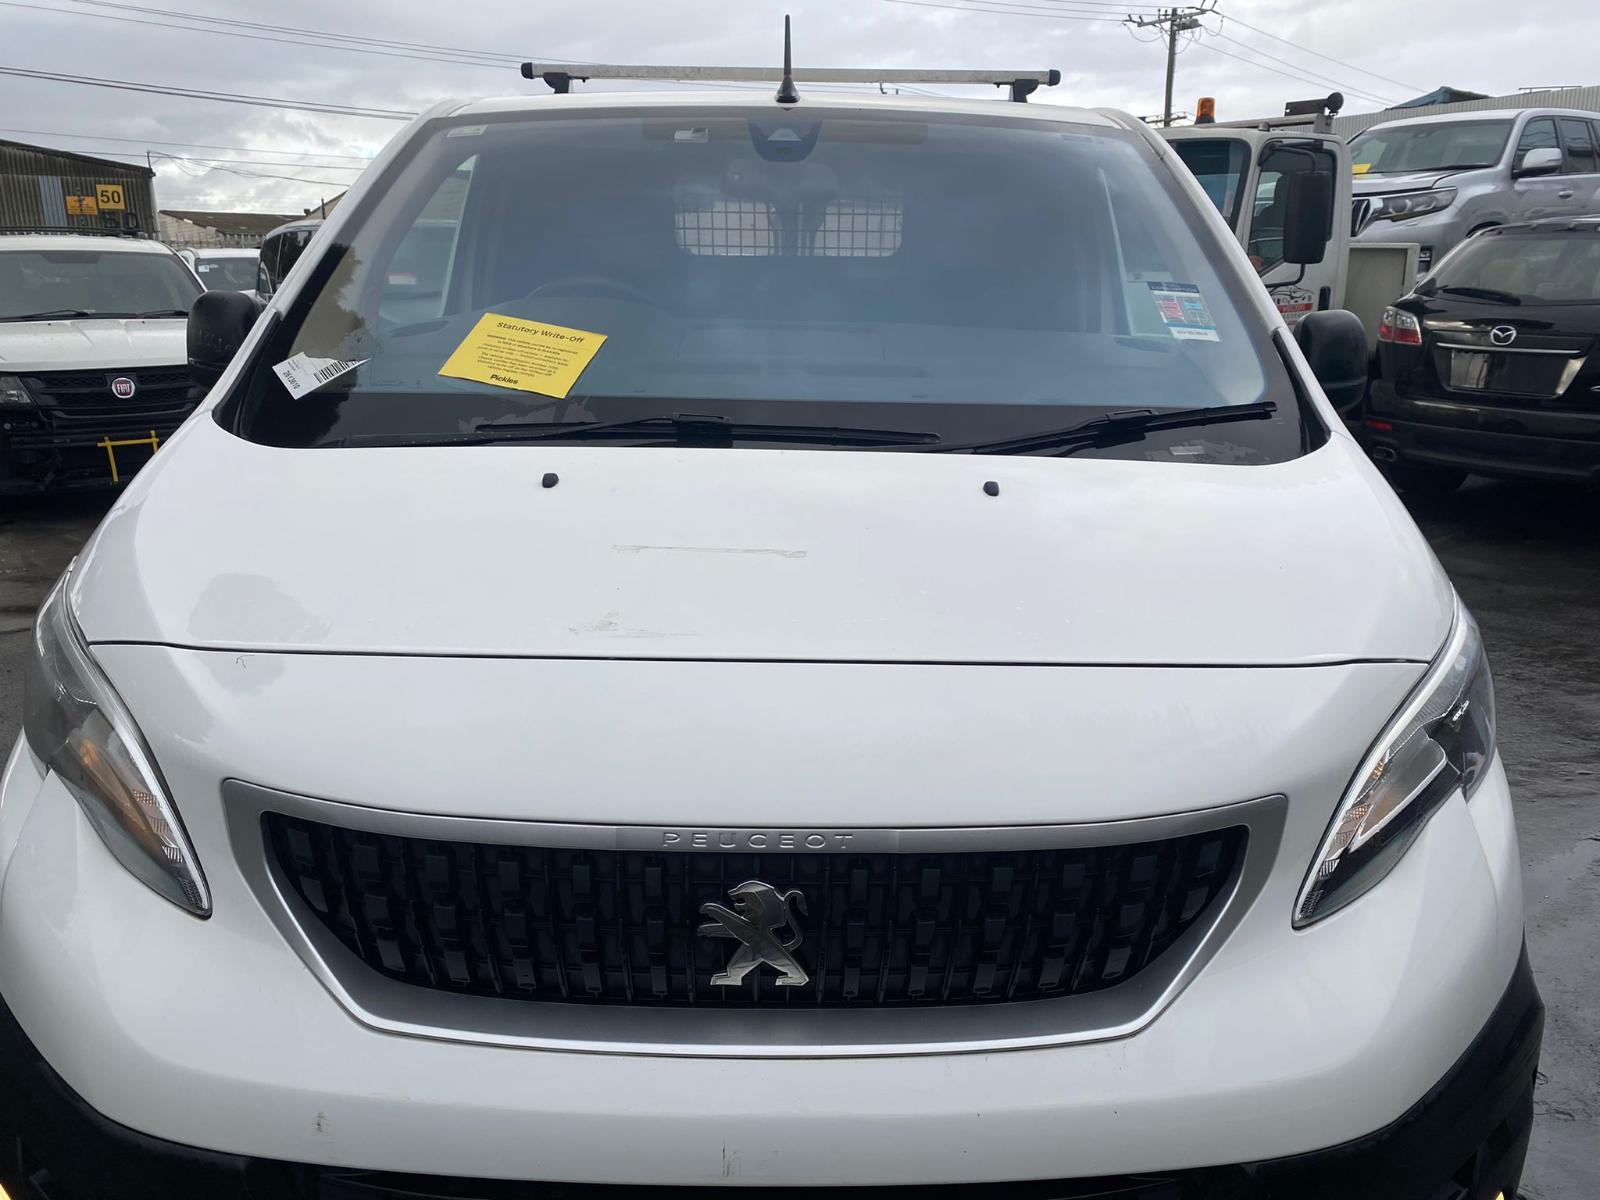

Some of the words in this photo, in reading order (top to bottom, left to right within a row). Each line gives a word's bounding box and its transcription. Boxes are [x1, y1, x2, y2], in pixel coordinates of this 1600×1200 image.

[100, 190, 121, 204] 50
[496, 321, 539, 336] Statutory
[541, 329, 585, 344] Write-Off
[490, 373, 519, 385] Pickles
[116, 383, 131, 394] FIAT
[662, 831, 854, 849] PEUGEOT
